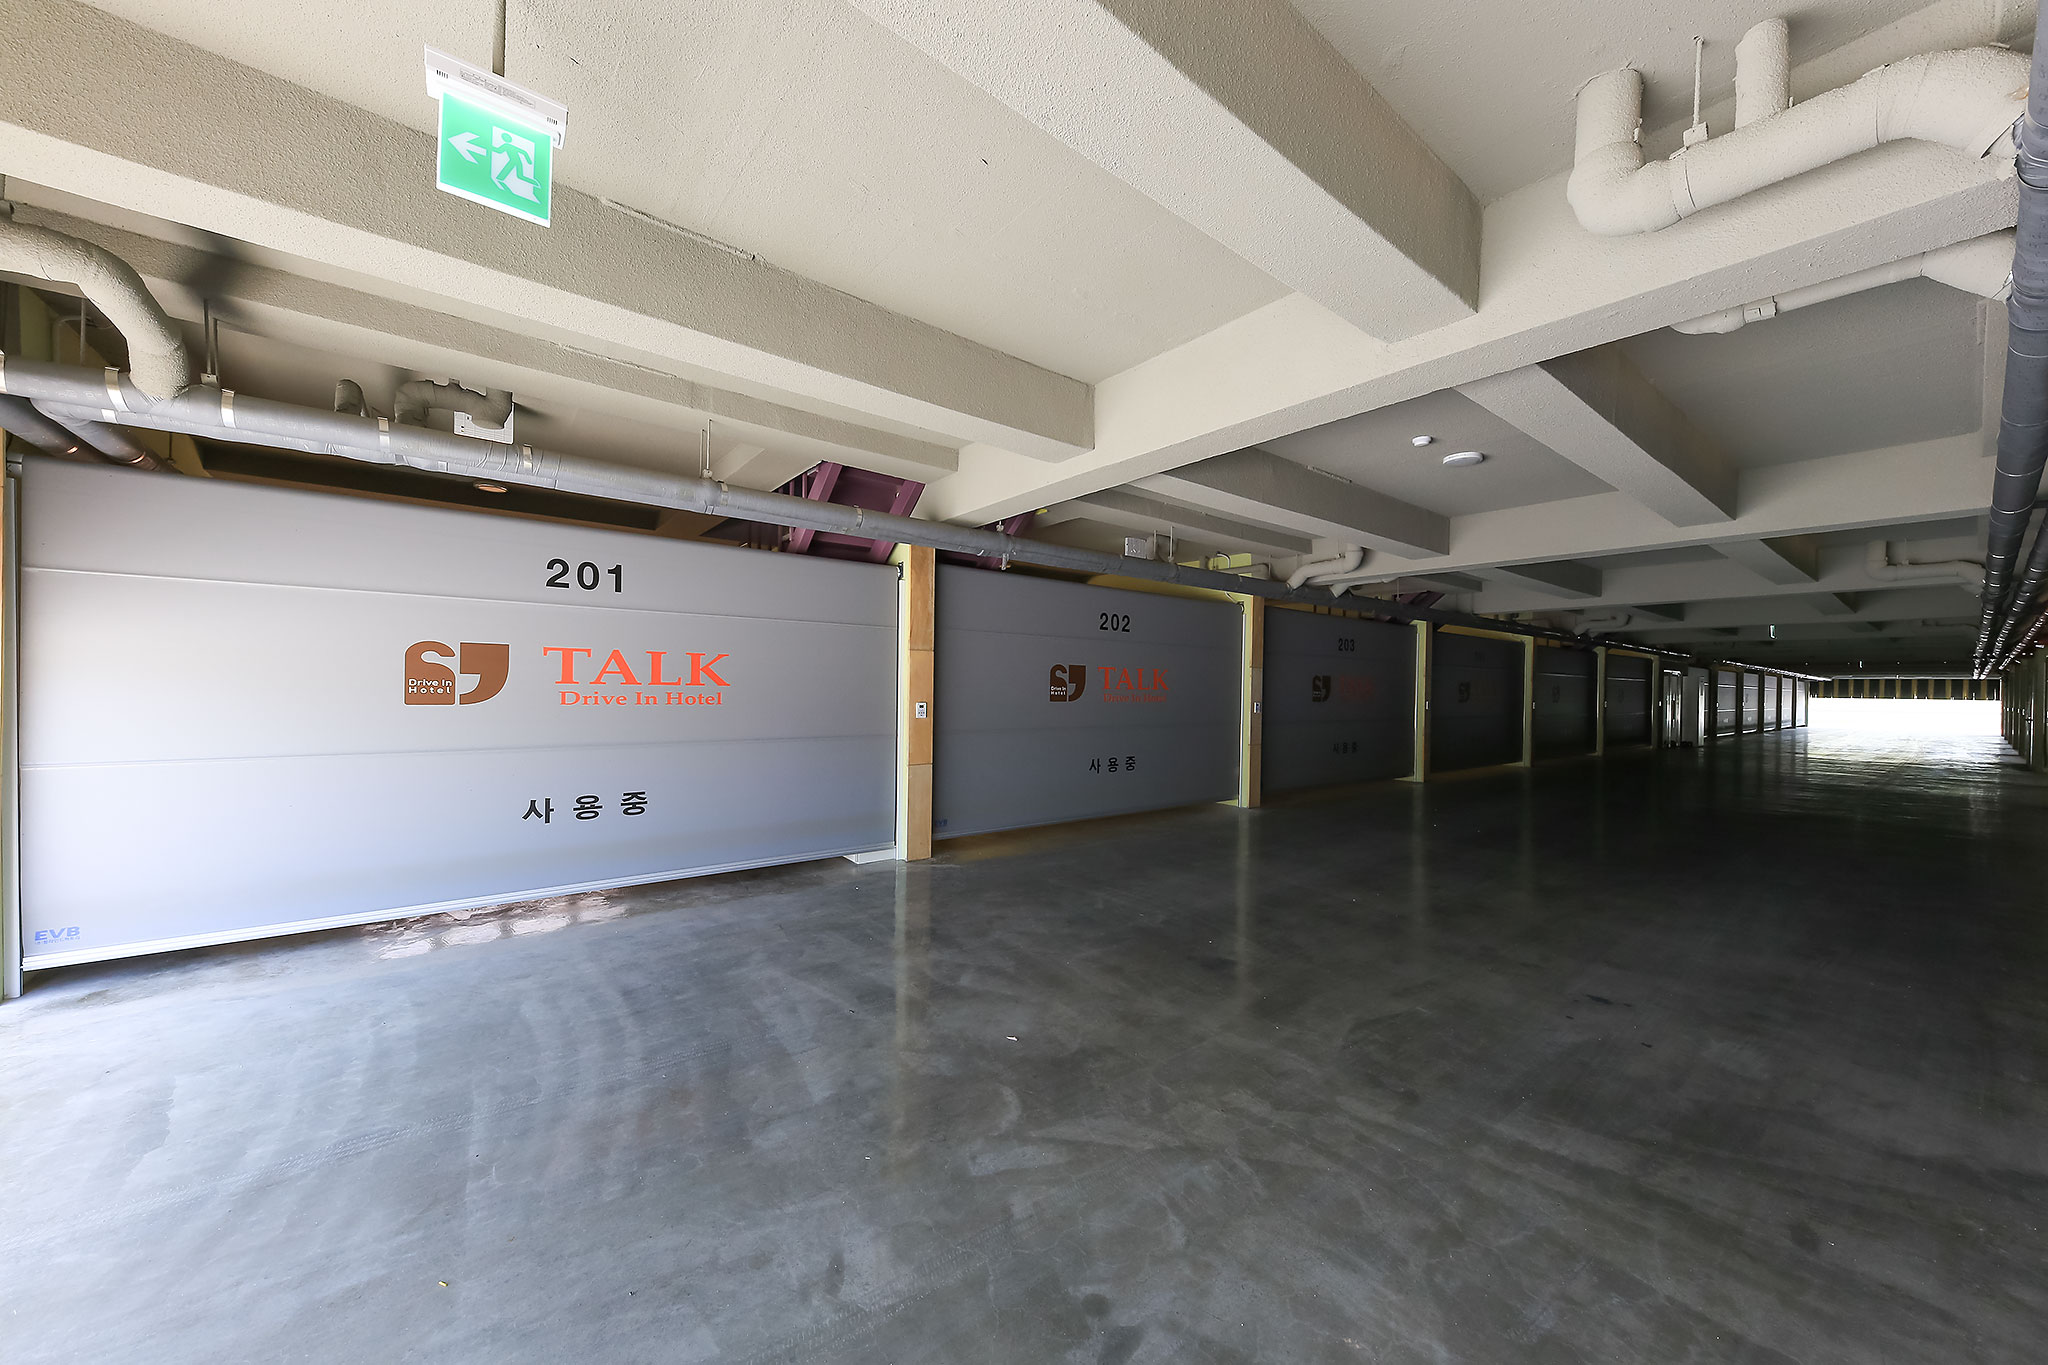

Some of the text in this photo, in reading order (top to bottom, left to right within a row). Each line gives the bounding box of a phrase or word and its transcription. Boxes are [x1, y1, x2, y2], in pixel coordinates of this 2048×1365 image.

[545, 558, 624, 593] 201
[1099, 612, 1131, 633] 202
[1338, 638, 1355, 652] 203
[543, 646, 731, 687] TALK
[408, 678, 453, 687] Drive In
[1097, 666, 1169, 691] TALK
[408, 686, 451, 694] Hotel
[558, 690, 722, 706] Drive In Hotel
[34, 926, 81, 941] EVB
